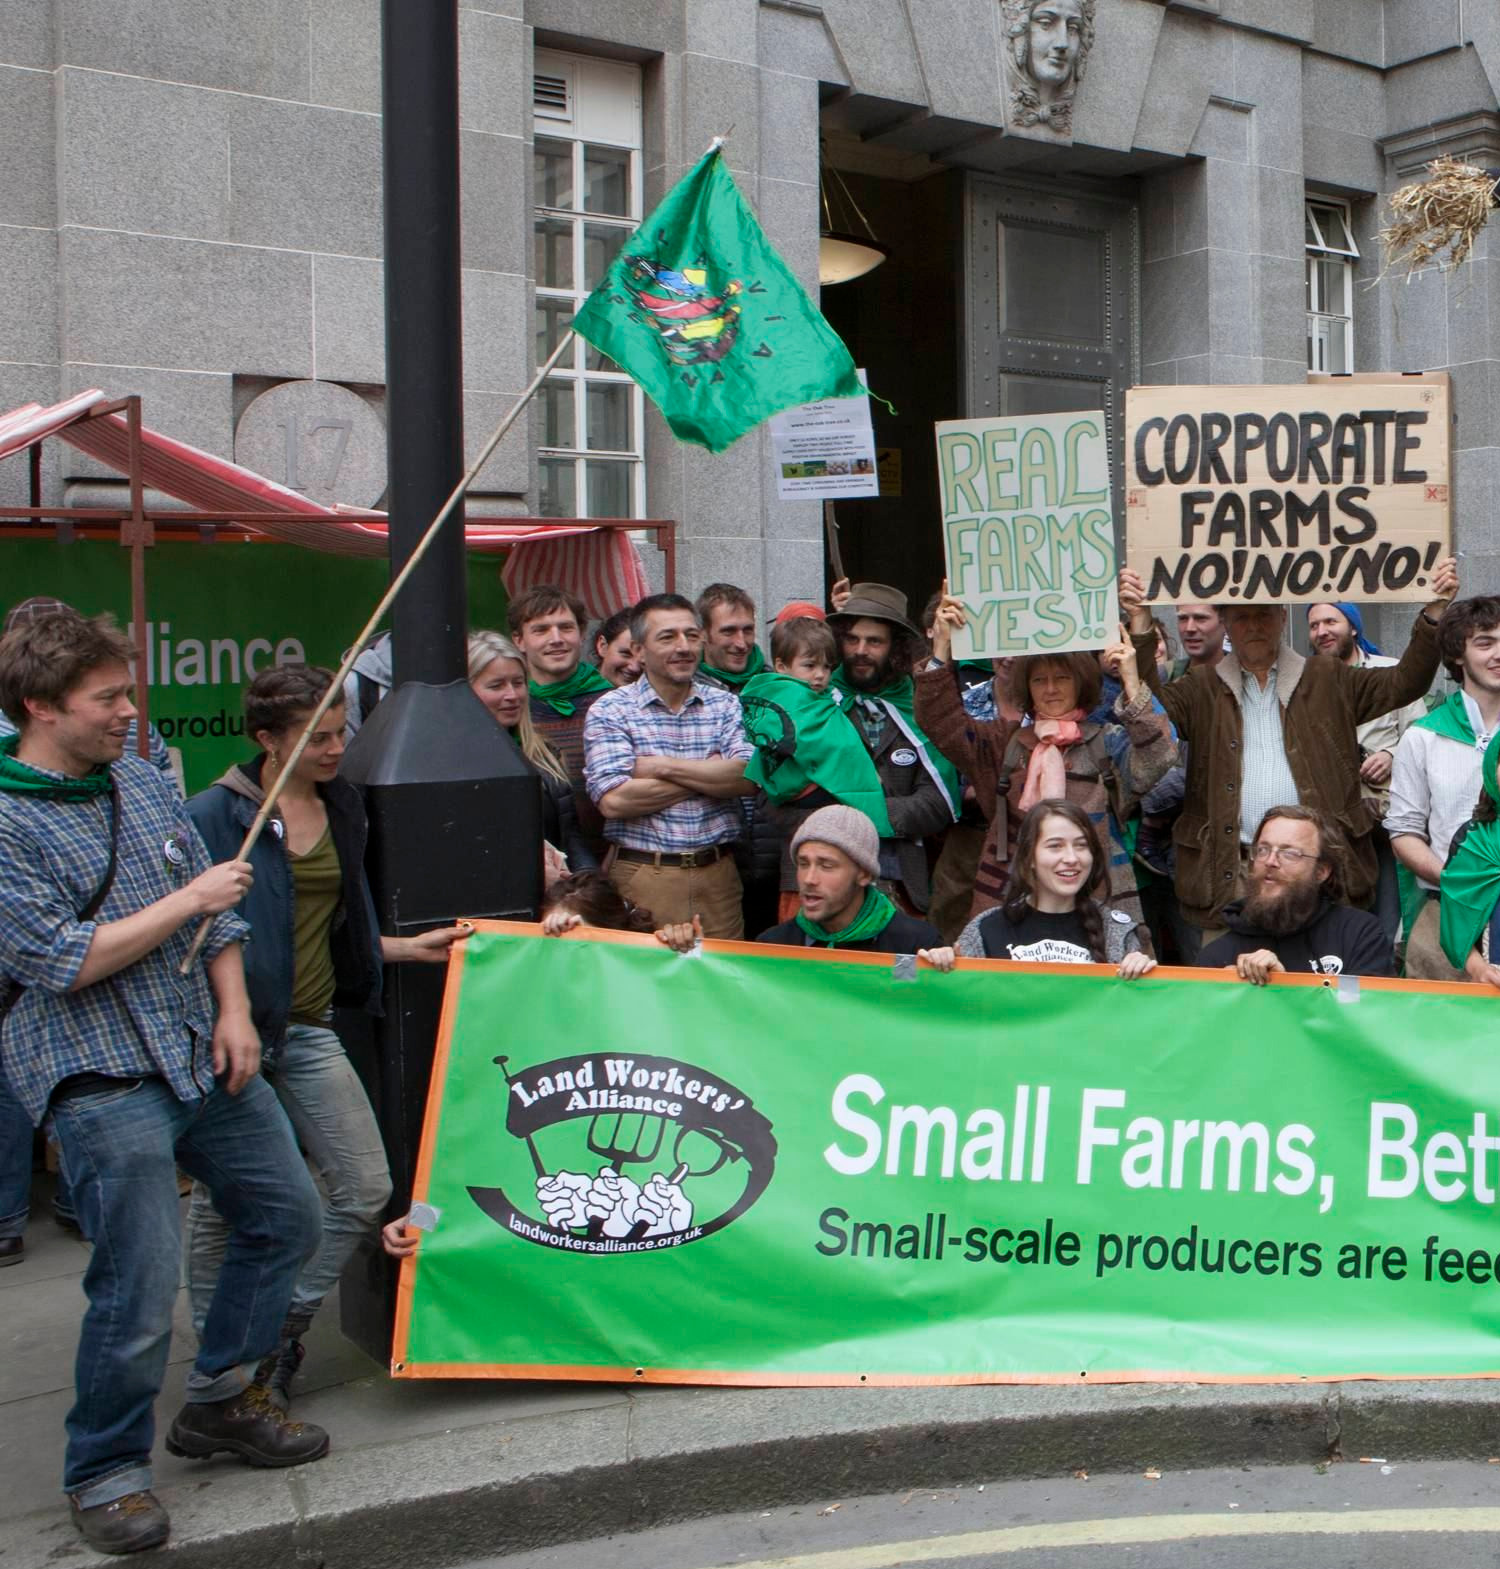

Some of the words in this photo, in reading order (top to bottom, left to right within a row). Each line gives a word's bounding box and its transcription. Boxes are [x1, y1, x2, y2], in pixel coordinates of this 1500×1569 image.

[277, 416, 352, 490] 17
[939, 419, 1108, 516] REAL
[1134, 410, 1429, 485] CORPORATE
[1181, 486, 1377, 548] FARMS
[947, 509, 1117, 597] FARMS
[128, 622, 306, 686] lliance
[964, 591, 1107, 653] YES!!
[157, 709, 244, 739] produ
[511, 1060, 595, 1108] Land
[565, 1088, 683, 1117] Alliance
[823, 1073, 1051, 1183] Small
[1076, 1087, 1334, 1214] Farms,
[509, 1212, 704, 1252] landworkersalliance.org.uk
[815, 1207, 1081, 1266] Small-scale
[1095, 1224, 1323, 1277] producers
[1337, 1242, 1408, 1281] are
